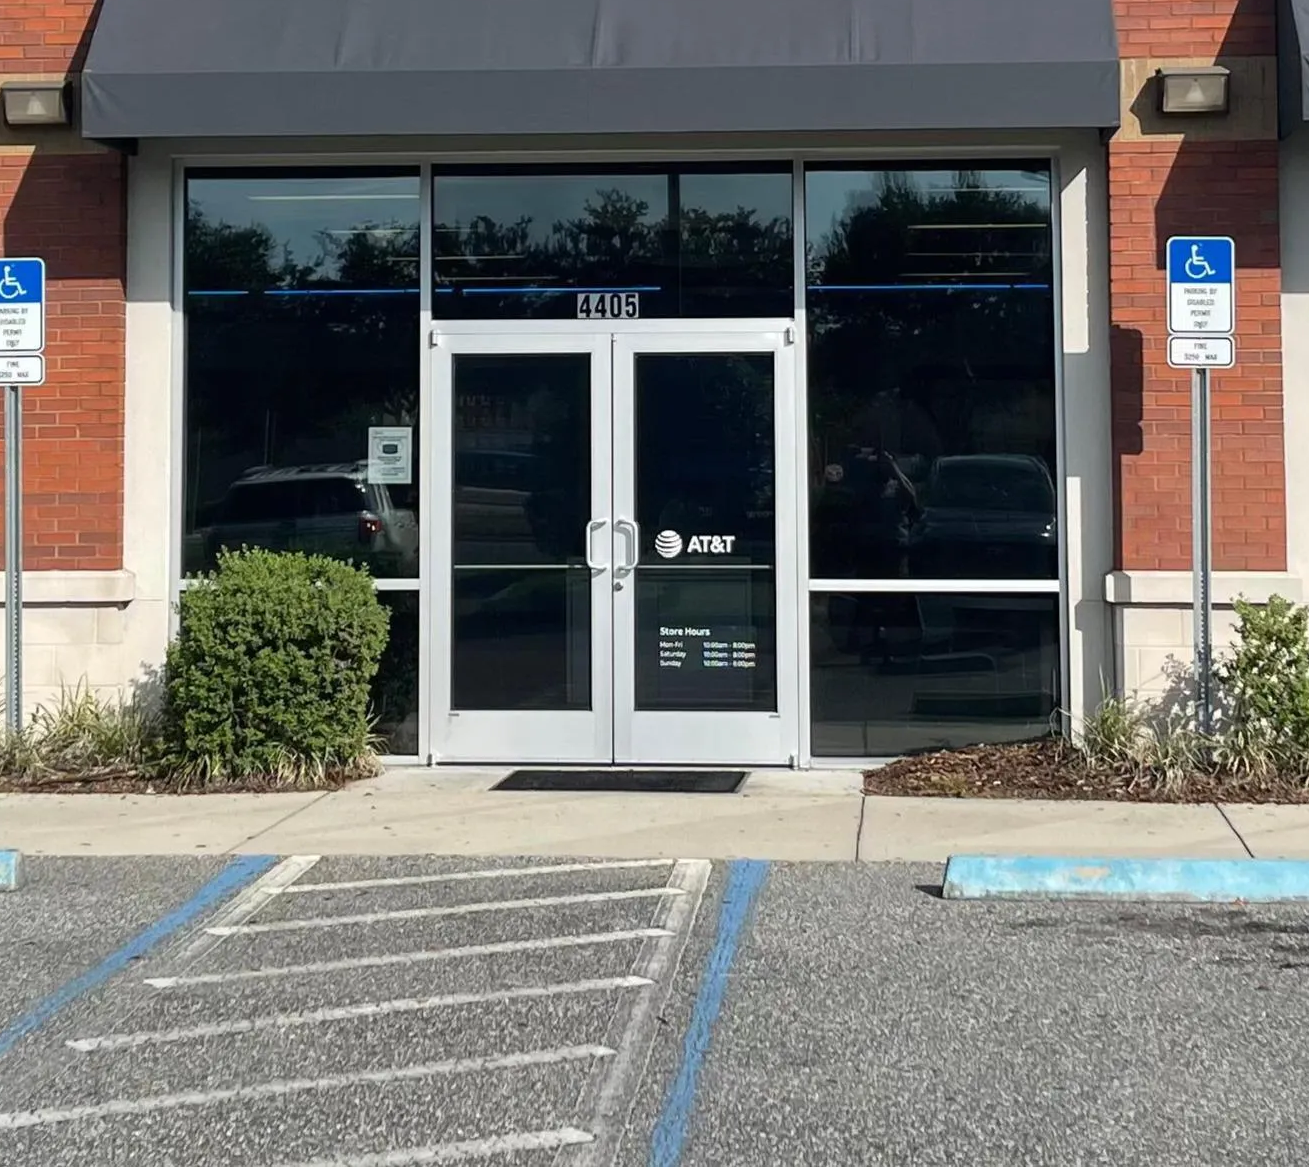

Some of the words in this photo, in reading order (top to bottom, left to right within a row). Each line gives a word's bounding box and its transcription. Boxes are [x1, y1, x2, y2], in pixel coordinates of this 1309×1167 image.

[579, 293, 637, 318] 4405
[687, 535, 736, 553] AT&T
[659, 627, 683, 636] Store
[685, 627, 710, 636] Hours
[659, 650, 686, 659] Saturday
